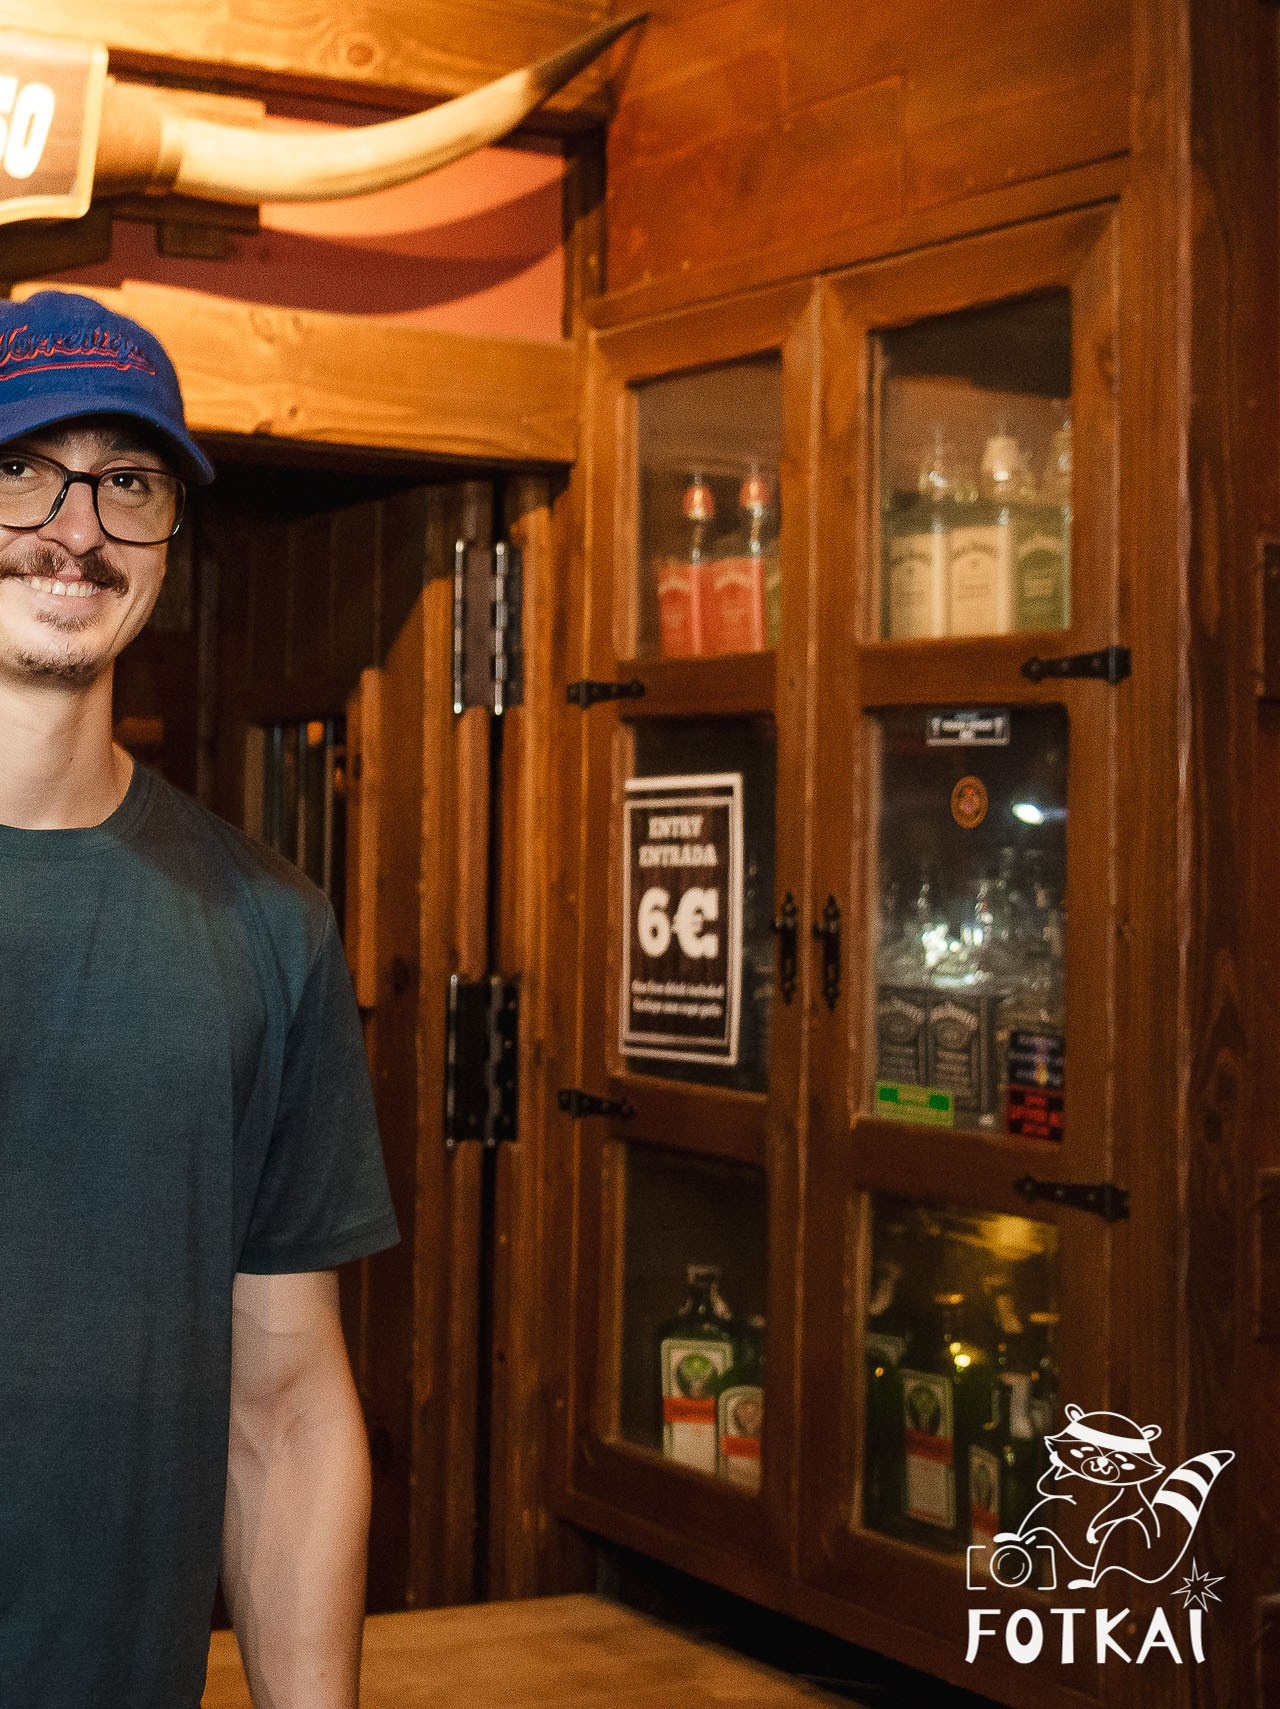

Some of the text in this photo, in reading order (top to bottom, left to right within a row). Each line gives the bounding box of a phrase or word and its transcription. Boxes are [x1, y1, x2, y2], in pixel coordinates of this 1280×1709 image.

[648, 815, 704, 838] ENTRY
[638, 843, 718, 867] ENTRADA
[637, 886, 719, 959] 6€
